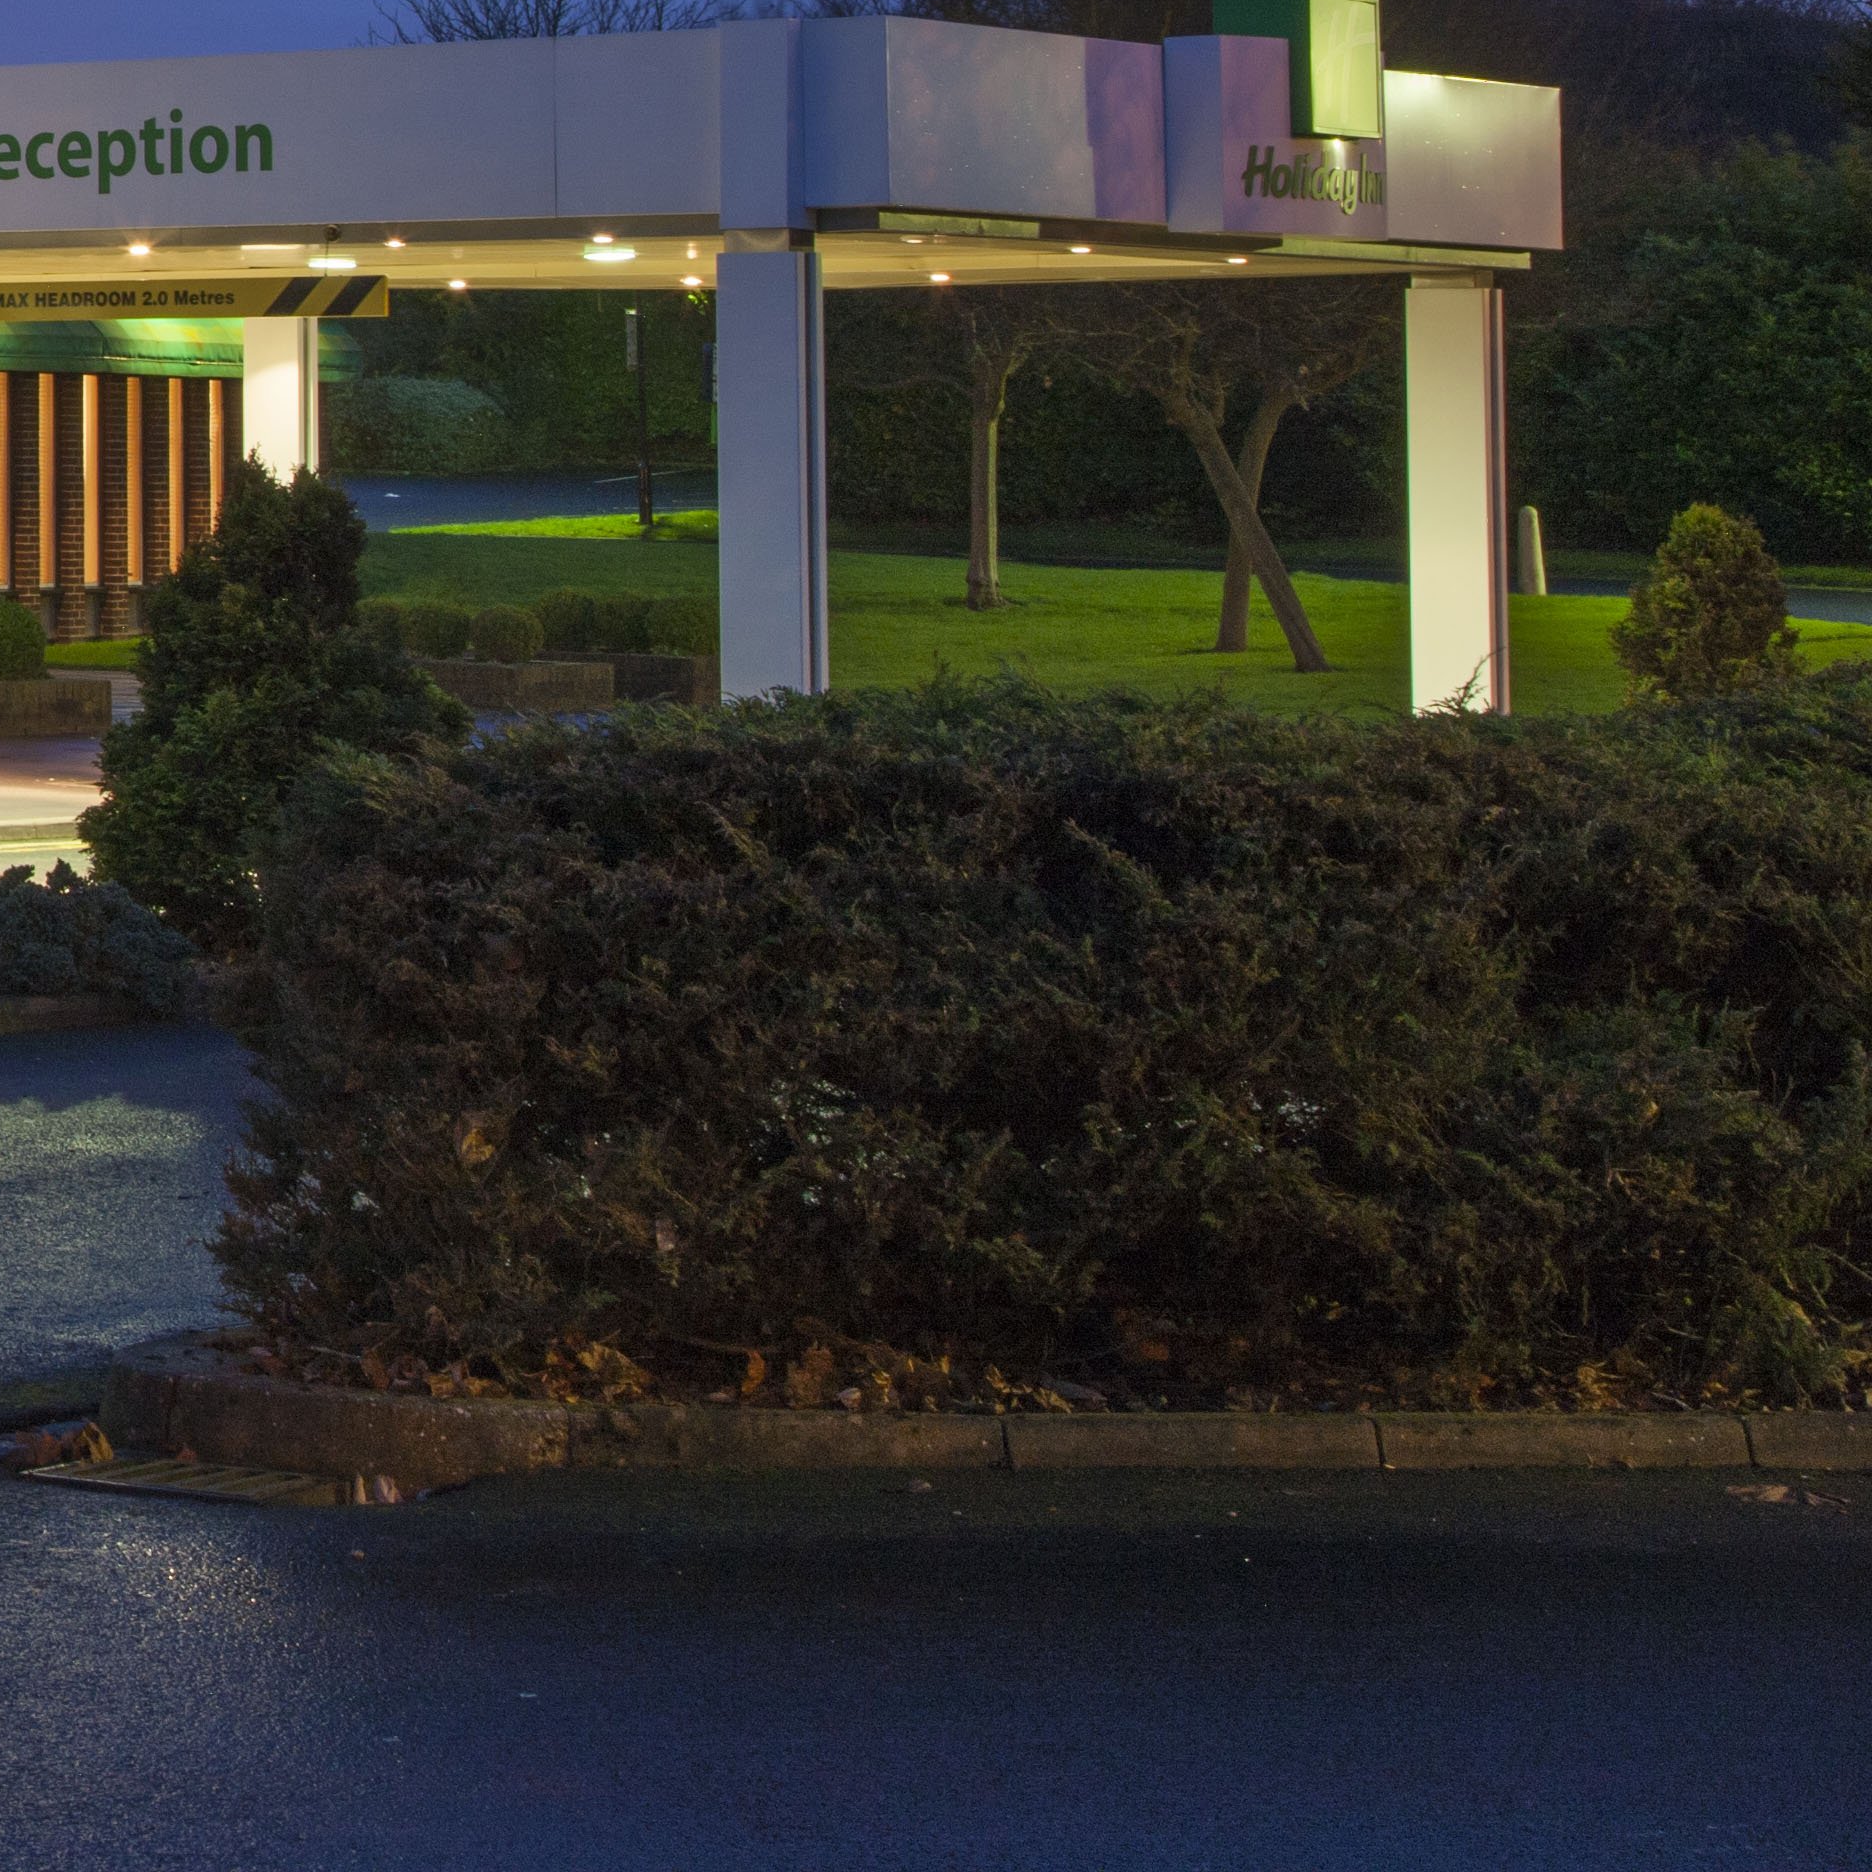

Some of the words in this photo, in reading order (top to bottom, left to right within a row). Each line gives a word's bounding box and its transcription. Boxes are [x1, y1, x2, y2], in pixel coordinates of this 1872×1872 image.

[1242, 144, 1358, 215] Holiday
[34, 291, 136, 307] HEADROOM
[143, 291, 168, 306] 2.0
[174, 290, 235, 305] Metres
